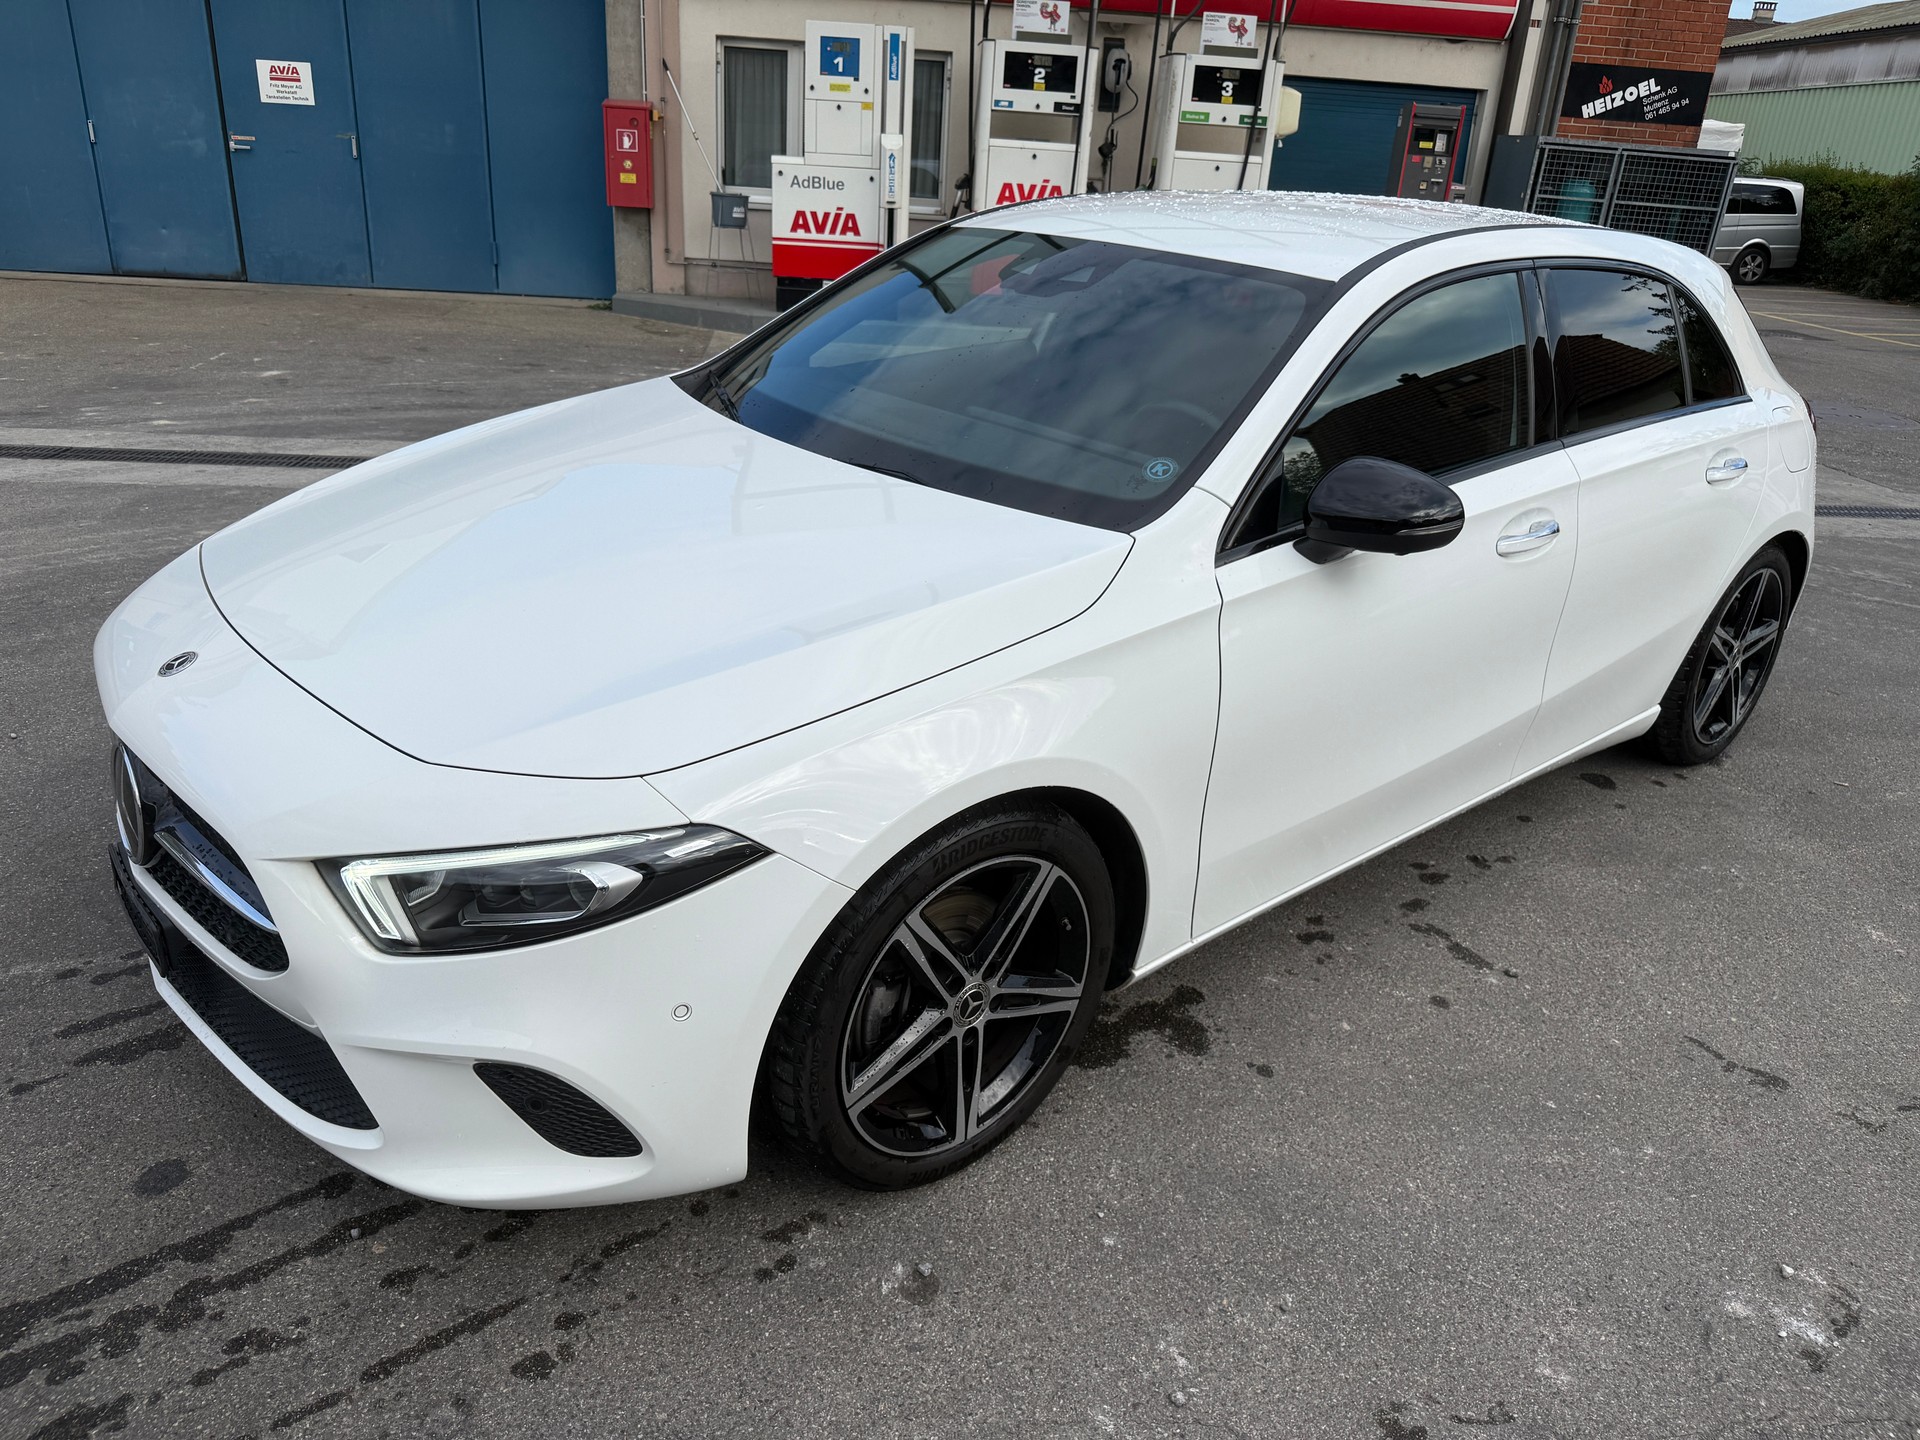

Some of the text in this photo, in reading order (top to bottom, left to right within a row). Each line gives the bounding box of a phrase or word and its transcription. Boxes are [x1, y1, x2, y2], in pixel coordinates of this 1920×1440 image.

[269, 64, 300, 75] AVIA
[833, 57, 844, 72] 1
[1033, 67, 1046, 83] 2
[1221, 81, 1234, 97] 3
[1642, 86, 1678, 105] Schenk AG
[1581, 78, 1661, 119] HEIZOEL
[1643, 98, 1669, 113] Muttenz
[1644, 98, 1690, 121] 061 465 94 94
[790, 175, 845, 190] AdBlue
[789, 206, 862, 237] AVIA
[931, 825, 1049, 876] BRIDGESTONE
